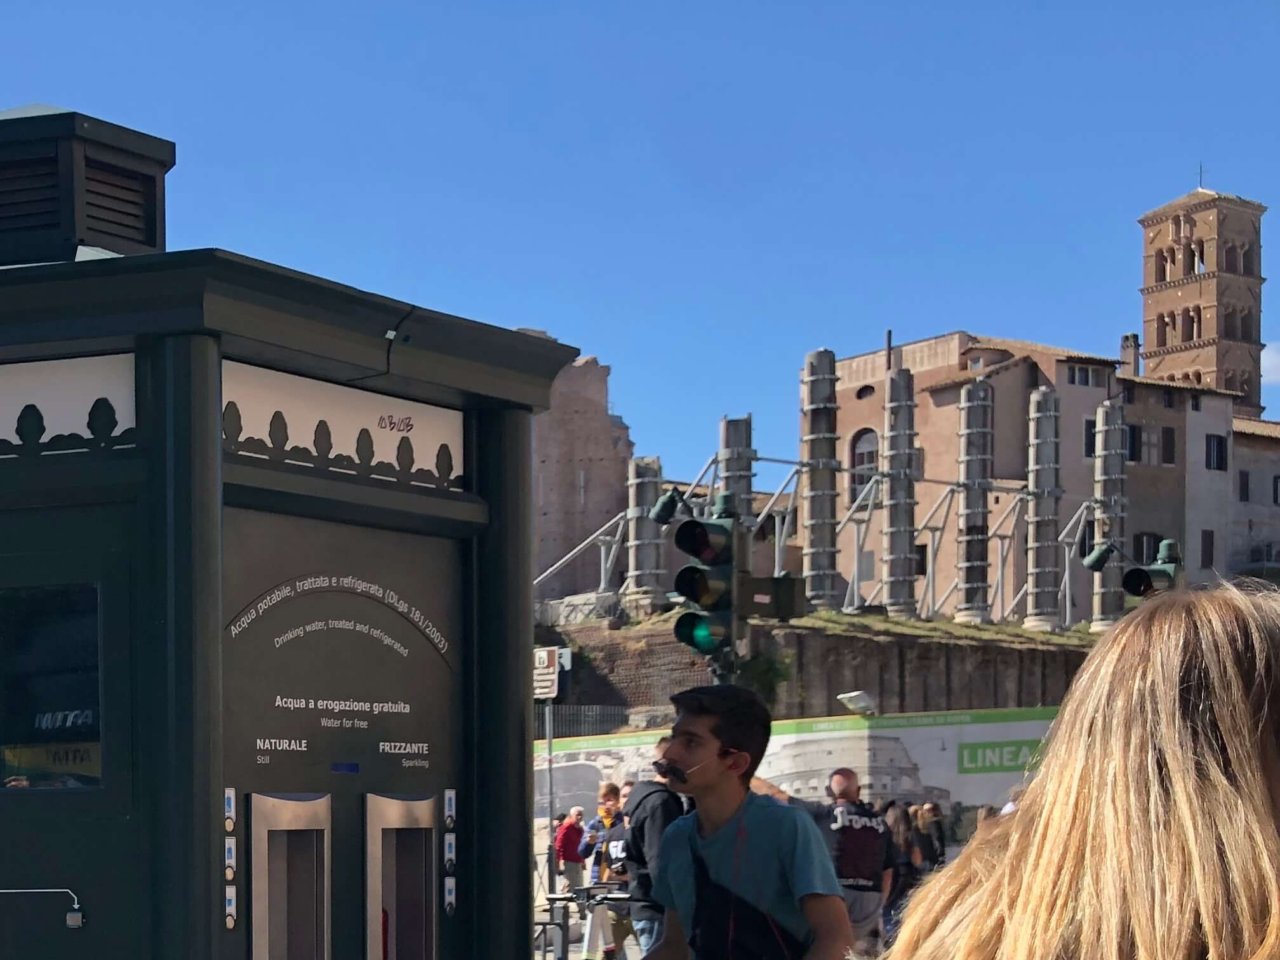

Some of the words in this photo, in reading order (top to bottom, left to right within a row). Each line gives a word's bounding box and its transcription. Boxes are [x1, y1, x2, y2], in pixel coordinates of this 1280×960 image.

[230, 608, 256, 638] Acqua
[258, 585, 295, 615] potabile,
[296, 575, 329, 593] trattata
[331, 577, 338, 586] e
[339, 576, 383, 597] refrigerata
[409, 607, 449, 654] 181/2003)
[274, 626, 304, 648] Drinking
[305, 620, 327, 633] water,
[328, 619, 355, 629] treated
[356, 622, 369, 633] and
[370, 627, 409, 657] refrigerated
[275, 695, 306, 710] Acqua
[308, 699, 315, 709] a
[317, 698, 371, 713] erogazione
[373, 700, 411, 714] gratuita
[320, 717, 341, 727] Water
[343, 718, 353, 728] for
[354, 718, 369, 729] free
[256, 738, 308, 751] NATURALE
[379, 742, 429, 754] FRIZZANTE
[256, 755, 270, 764] Still
[402, 757, 429, 768] Sparkling
[961, 747, 1031, 769] LINEA
